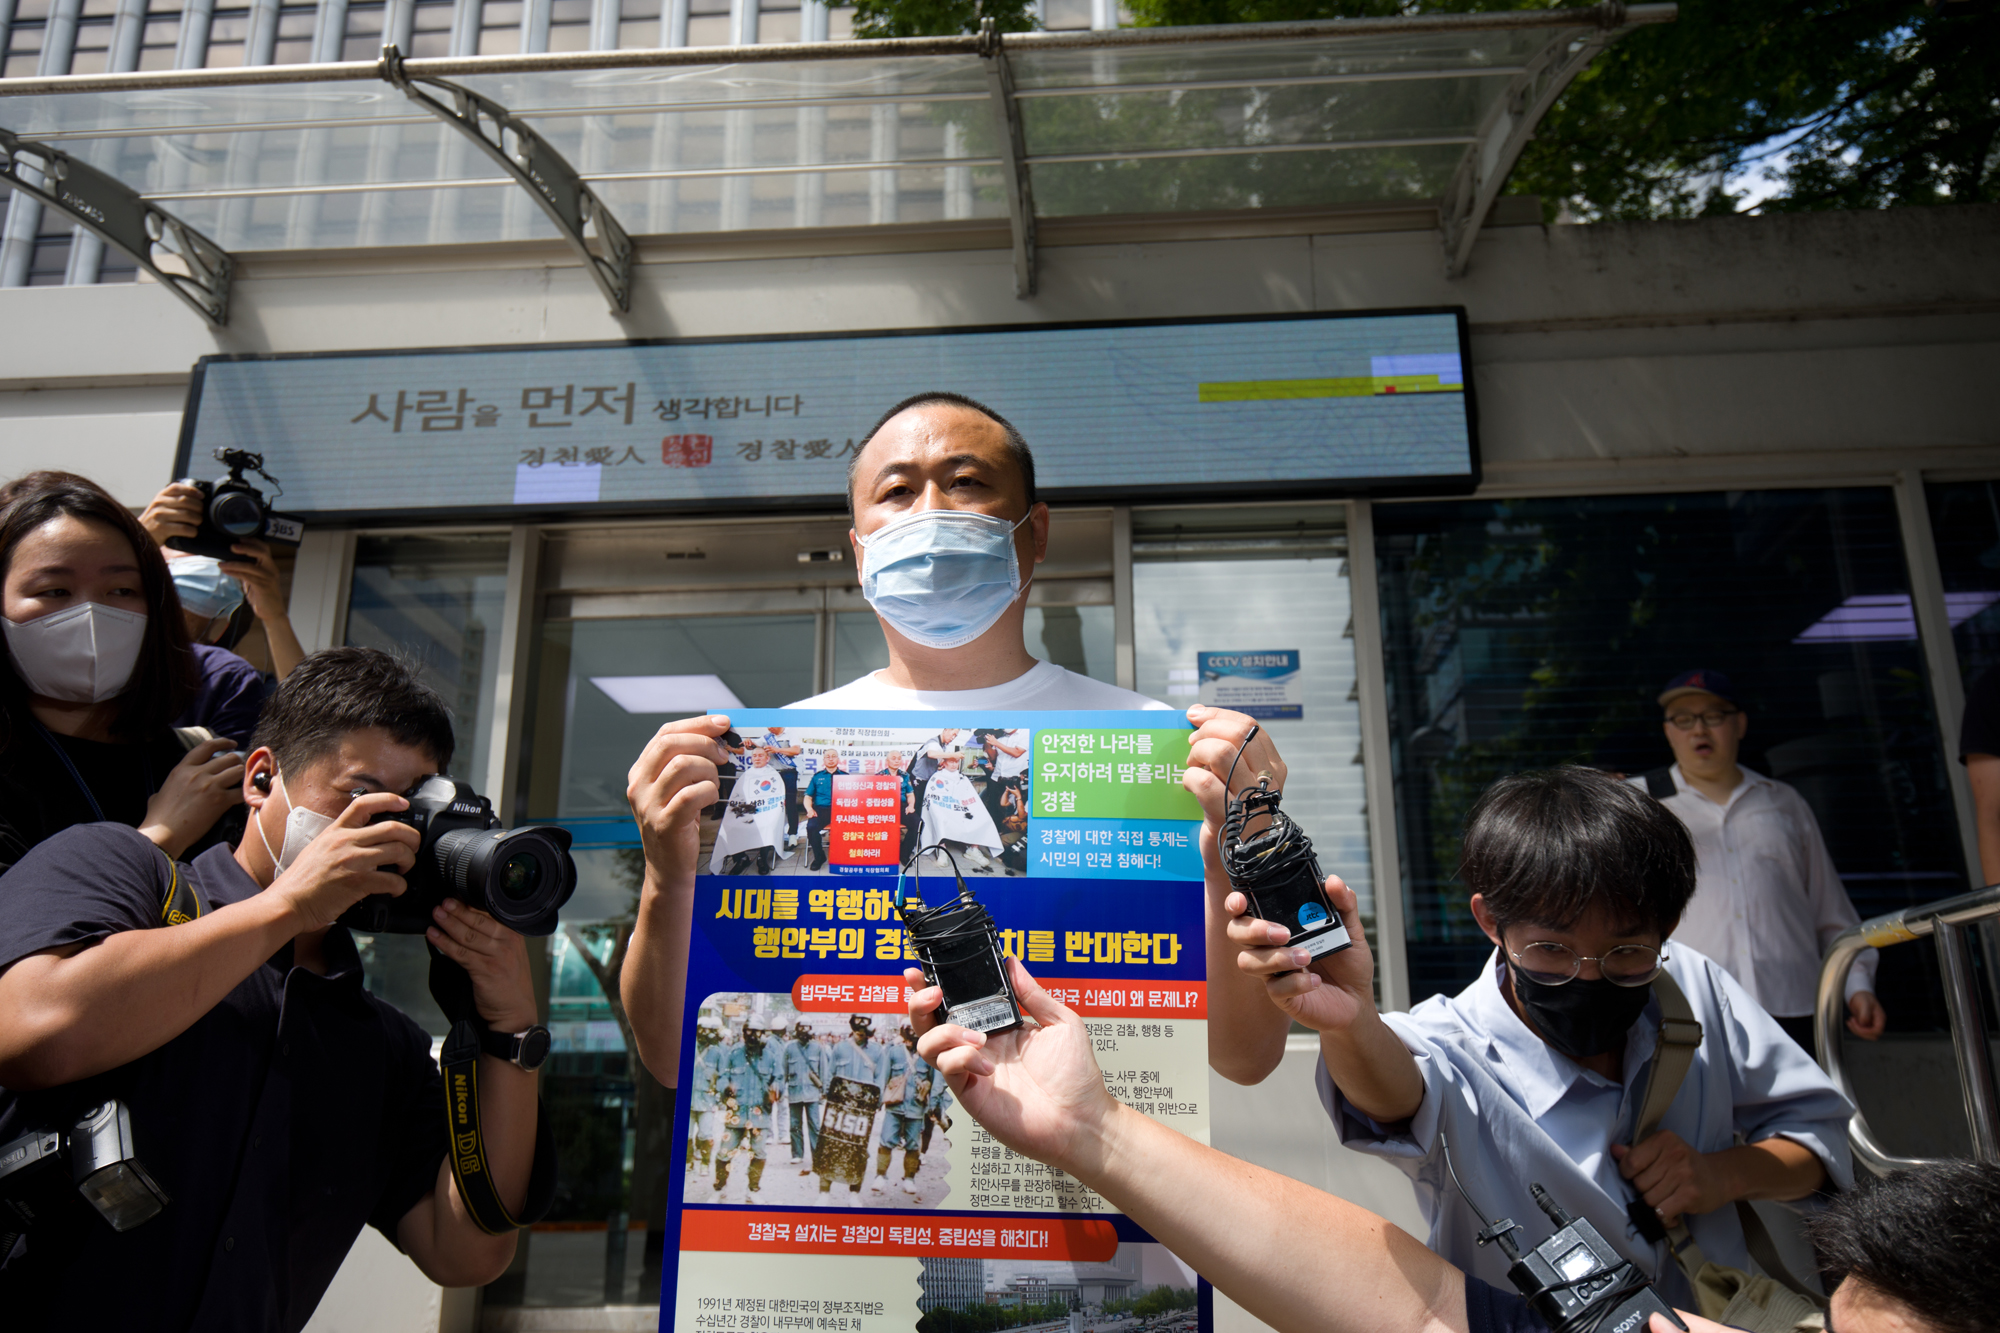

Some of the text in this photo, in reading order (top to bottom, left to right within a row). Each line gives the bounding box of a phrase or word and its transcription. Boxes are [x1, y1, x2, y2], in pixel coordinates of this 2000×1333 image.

[350, 381, 804, 434] 사람을 먼저 생각합니다
[1208, 654, 1289, 668] CCTV 설치안내
[1041, 734, 1154, 755] 안전한 나라를
[1041, 762, 1187, 785] 유지하려 땀흘리는
[875, 781, 897, 791] 경찰의
[453, 802, 482, 815] Nikon
[836, 798, 894, 807] 독립성 중립성을
[1041, 791, 1077, 812] 경찰
[836, 814, 896, 823] 무시하는 행안부의
[842, 831, 888, 841] 경찰국 신설을
[1040, 829, 1081, 845] 경찰에
[1085, 830, 1113, 846] 대한
[1117, 831, 1144, 846] 직접
[1147, 831, 1189, 847] 통제는
[1040, 852, 1162, 869] 시민의 인권 침해다!
[715, 889, 800, 921] 시대를
[753, 926, 865, 960] 행안부의
[1065, 931, 1182, 965] 반대한다
[801, 985, 855, 1002] 법무부도
[859, 985, 900, 1003] 검찰을
[1084, 989, 1126, 1007] 신설이
[1129, 990, 1144, 1008] 왜
[1148, 990, 1199, 1008] 문제냐?
[1116, 1024, 1139, 1038] 검찰,
[1141, 1024, 1161, 1038] 행형
[1163, 1025, 1174, 1038] 등
[1096, 1039, 1119, 1051] 있다.
[1116, 1070, 1137, 1083] 사무
[1140, 1071, 1160, 1083] 중에
[454, 1074, 468, 1125] Nikon
[1133, 1086, 1173, 1099] 행안부에
[1158, 1102, 1198, 1115] 위반으로
[970, 1146, 1002, 1160] 부령을
[970, 1162, 1011, 1176] 신설하고
[970, 1178, 1021, 1192] 치안사무를
[1023, 1179, 1075, 1194] 관장하려는
[970, 1194, 1104, 1210] 정면으로 반한다고 할수 있다.
[748, 1222, 791, 1241] 경찰국
[794, 1223, 838, 1243] 설치는
[841, 1225, 885, 1245] 경찰의
[938, 1228, 997, 1247] 중립성을
[1000, 1229, 1049, 1249] 해친다!
[697, 1297, 885, 1316] 1991년 제정된 대한민국의 정부조직법은
[695, 1314, 862, 1331] 수십년간 경찰이 내무부에 예속된 채
[1612, 1310, 1643, 1333] SONY
